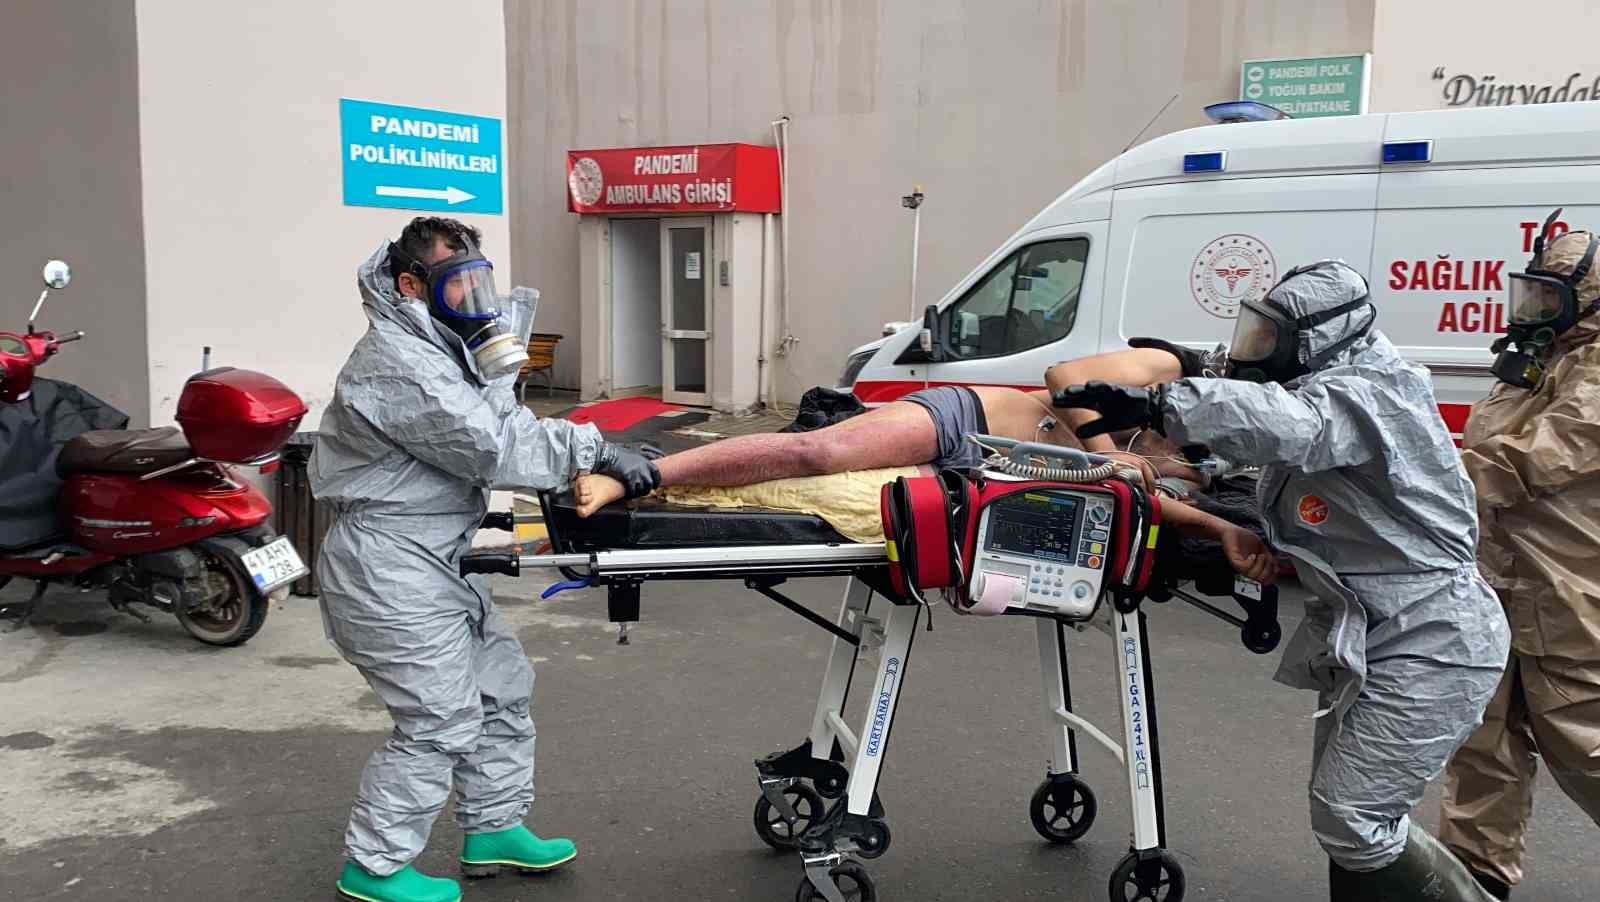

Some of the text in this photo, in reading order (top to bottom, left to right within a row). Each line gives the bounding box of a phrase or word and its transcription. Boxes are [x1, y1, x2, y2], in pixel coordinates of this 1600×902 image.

[370, 114, 480, 144] PANDEMİ
[350, 143, 498, 174] POLİKLİNİKLERİ
[634, 148, 699, 175] PANDEMİ
[606, 177, 732, 209] AMBULANS GİRİŞİ
[1389, 253, 1505, 291] SAĞLIK
[1437, 297, 1509, 334] ACİL
[248, 552, 265, 568] 41
[1128, 672, 1141, 707] TGA
[868, 696, 890, 756] KARTSANA
[1132, 711, 1144, 746] 241
